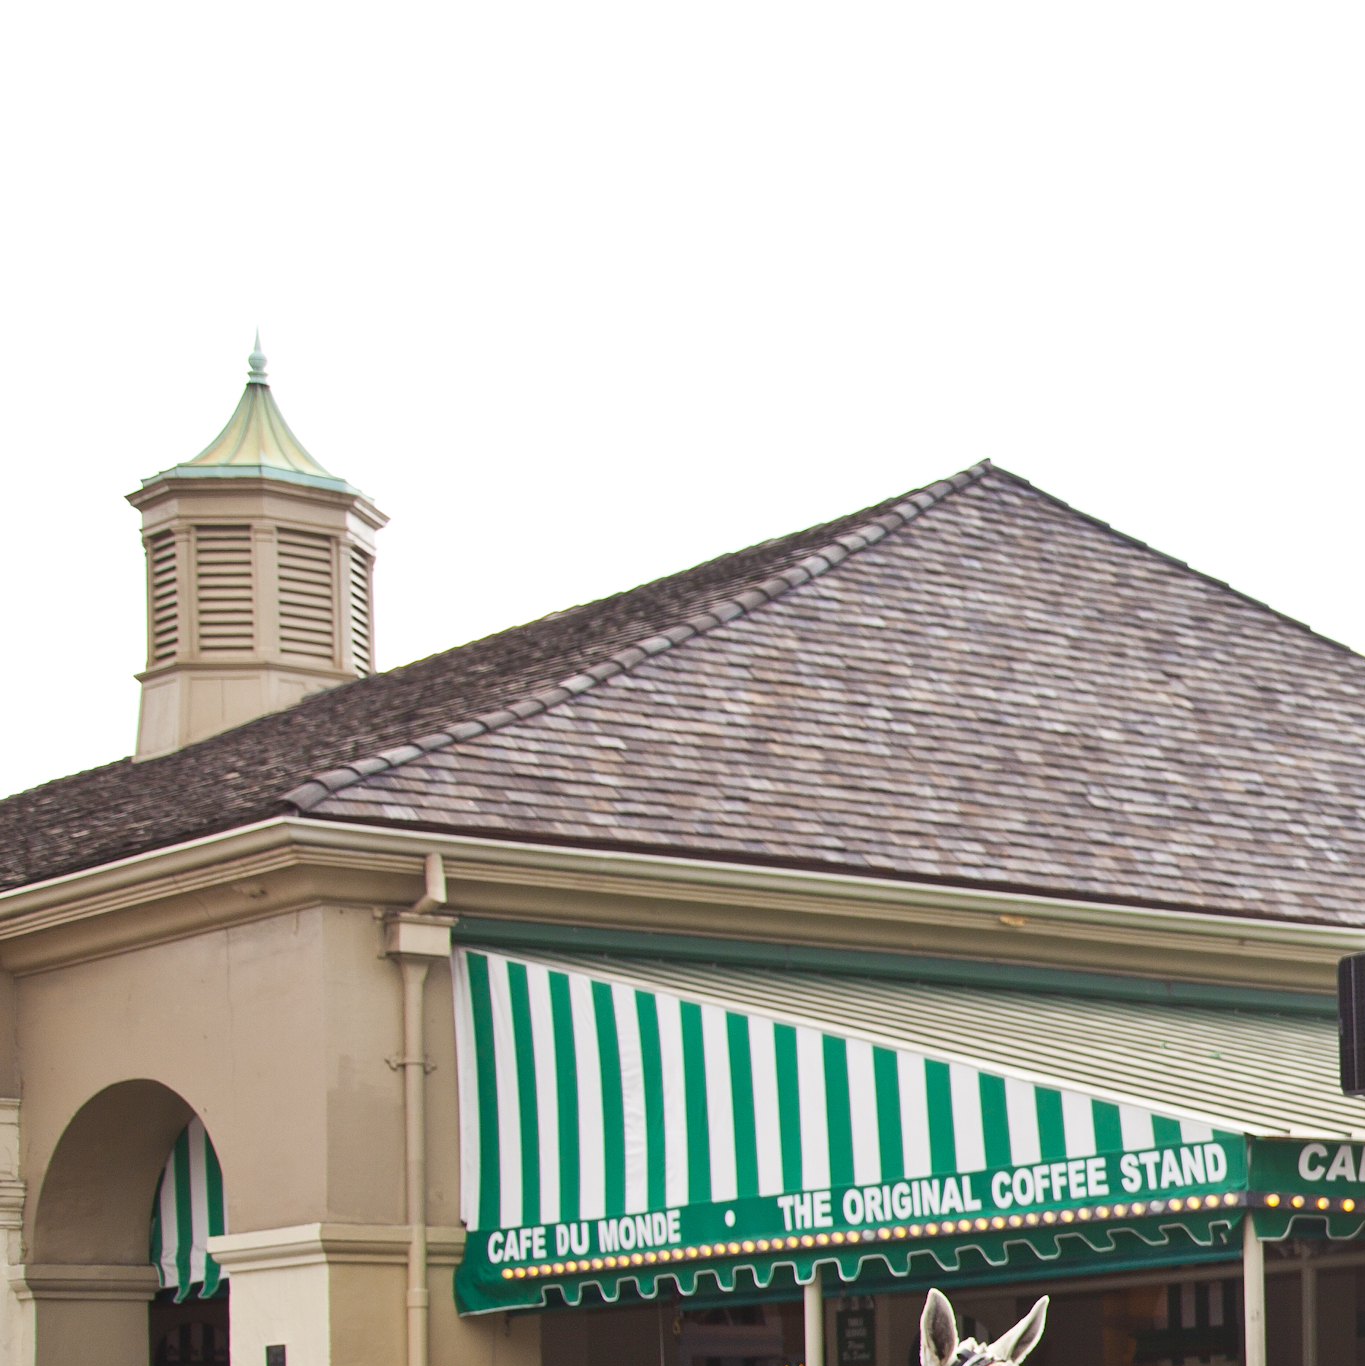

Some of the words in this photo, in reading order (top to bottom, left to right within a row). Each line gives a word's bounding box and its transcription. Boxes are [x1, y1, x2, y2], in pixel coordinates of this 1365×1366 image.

[487, 1226, 547, 1264] CAFE
[556, 1222, 590, 1256] DU
[598, 1209, 681, 1253] MONDE
[777, 1190, 833, 1231] THE
[843, 1175, 981, 1226] ORIGINAL
[992, 1156, 1109, 1208] COFFEE
[1121, 1143, 1228, 1193] STAND
